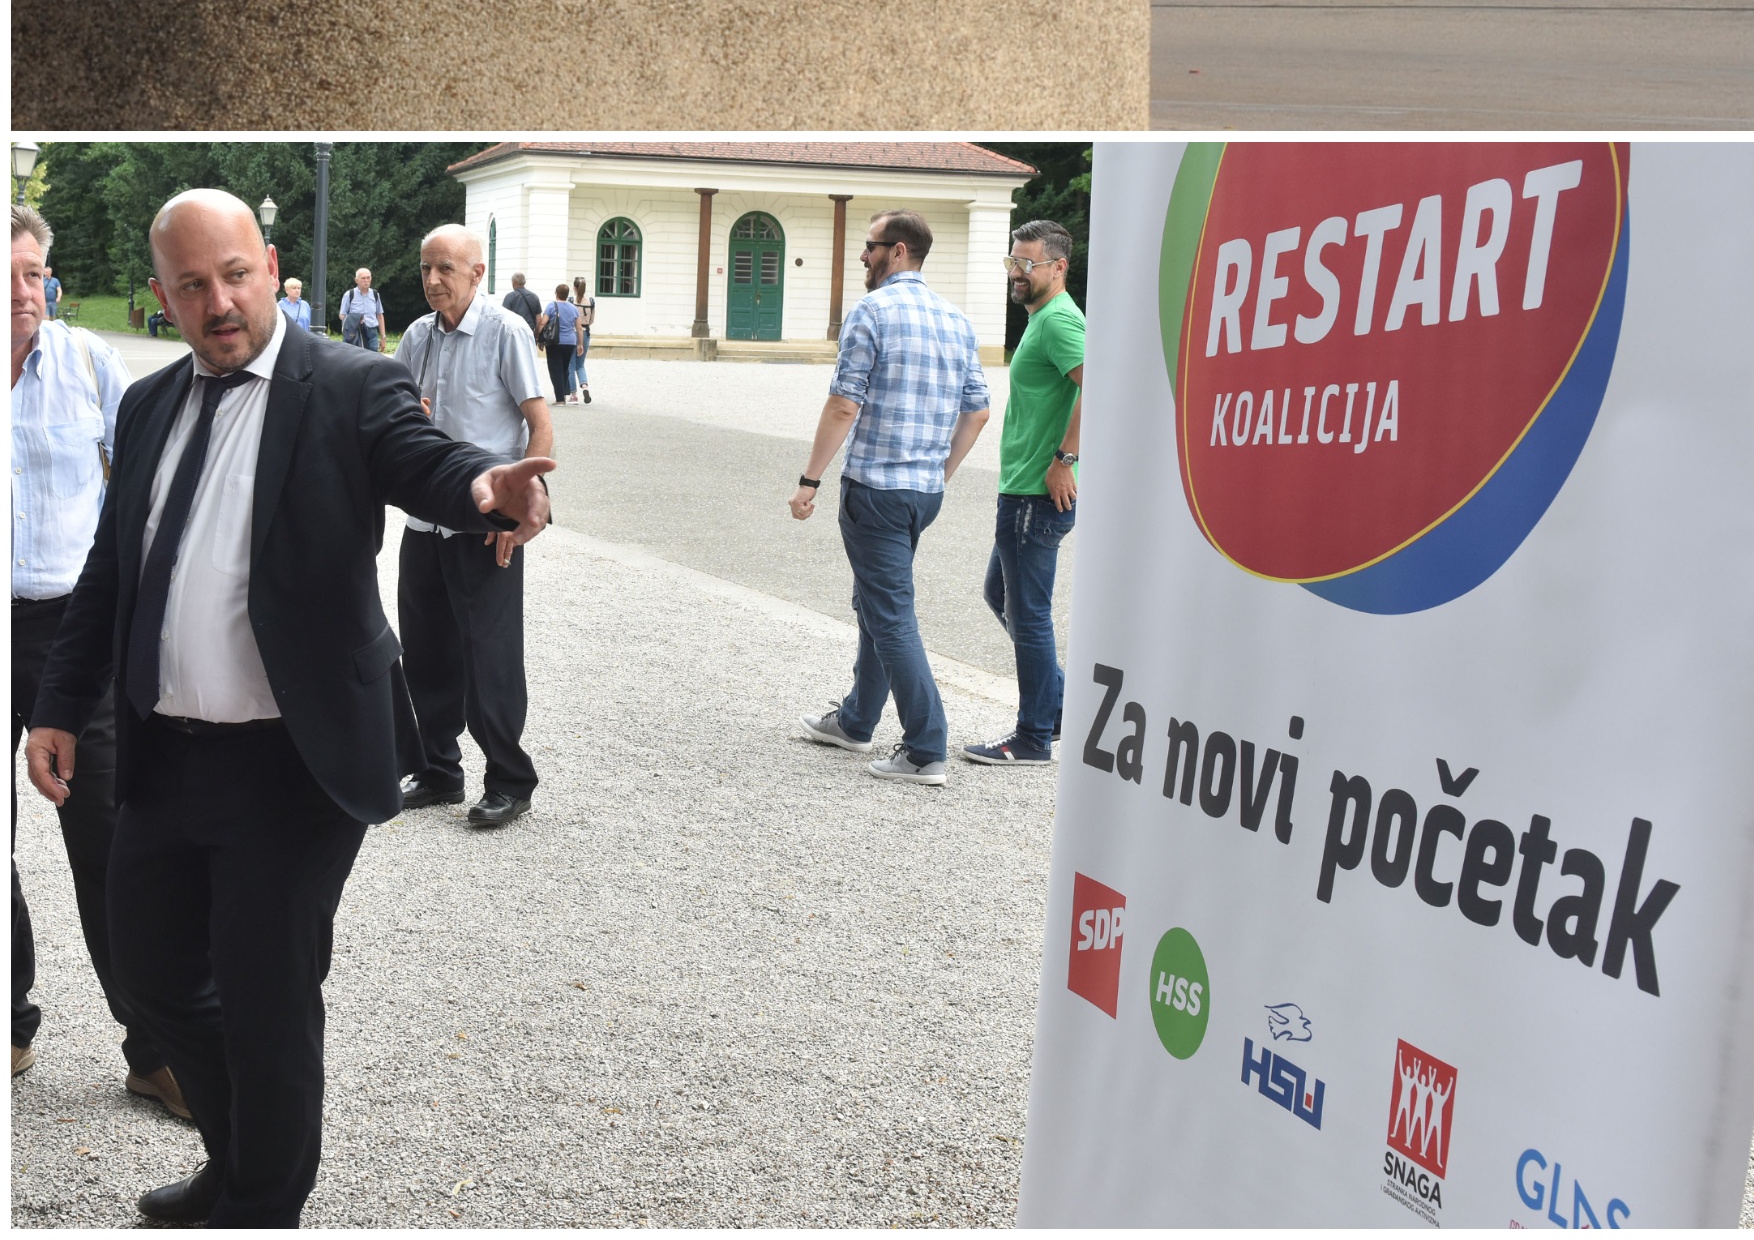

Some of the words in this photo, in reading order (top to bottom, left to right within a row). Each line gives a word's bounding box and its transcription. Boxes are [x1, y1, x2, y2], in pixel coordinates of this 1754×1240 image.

[1205, 159, 1583, 358] RESTART
[1210, 380, 1399, 454] KOALICIJA
[1083, 663, 1146, 785] Za
[1162, 716, 1304, 845] novi
[1316, 757, 1681, 998] početak
[1077, 907, 1125, 951] SDP
[1156, 971, 1203, 1017] HSS
[1241, 1037, 1325, 1131] HSU
[1384, 1151, 1442, 1209] SNAGA
[1387, 1179, 1408, 1197] STRANKA
[1408, 1192, 1436, 1216] NARODNOG
[1415, 1207, 1440, 1229] AKTIVIZMA
